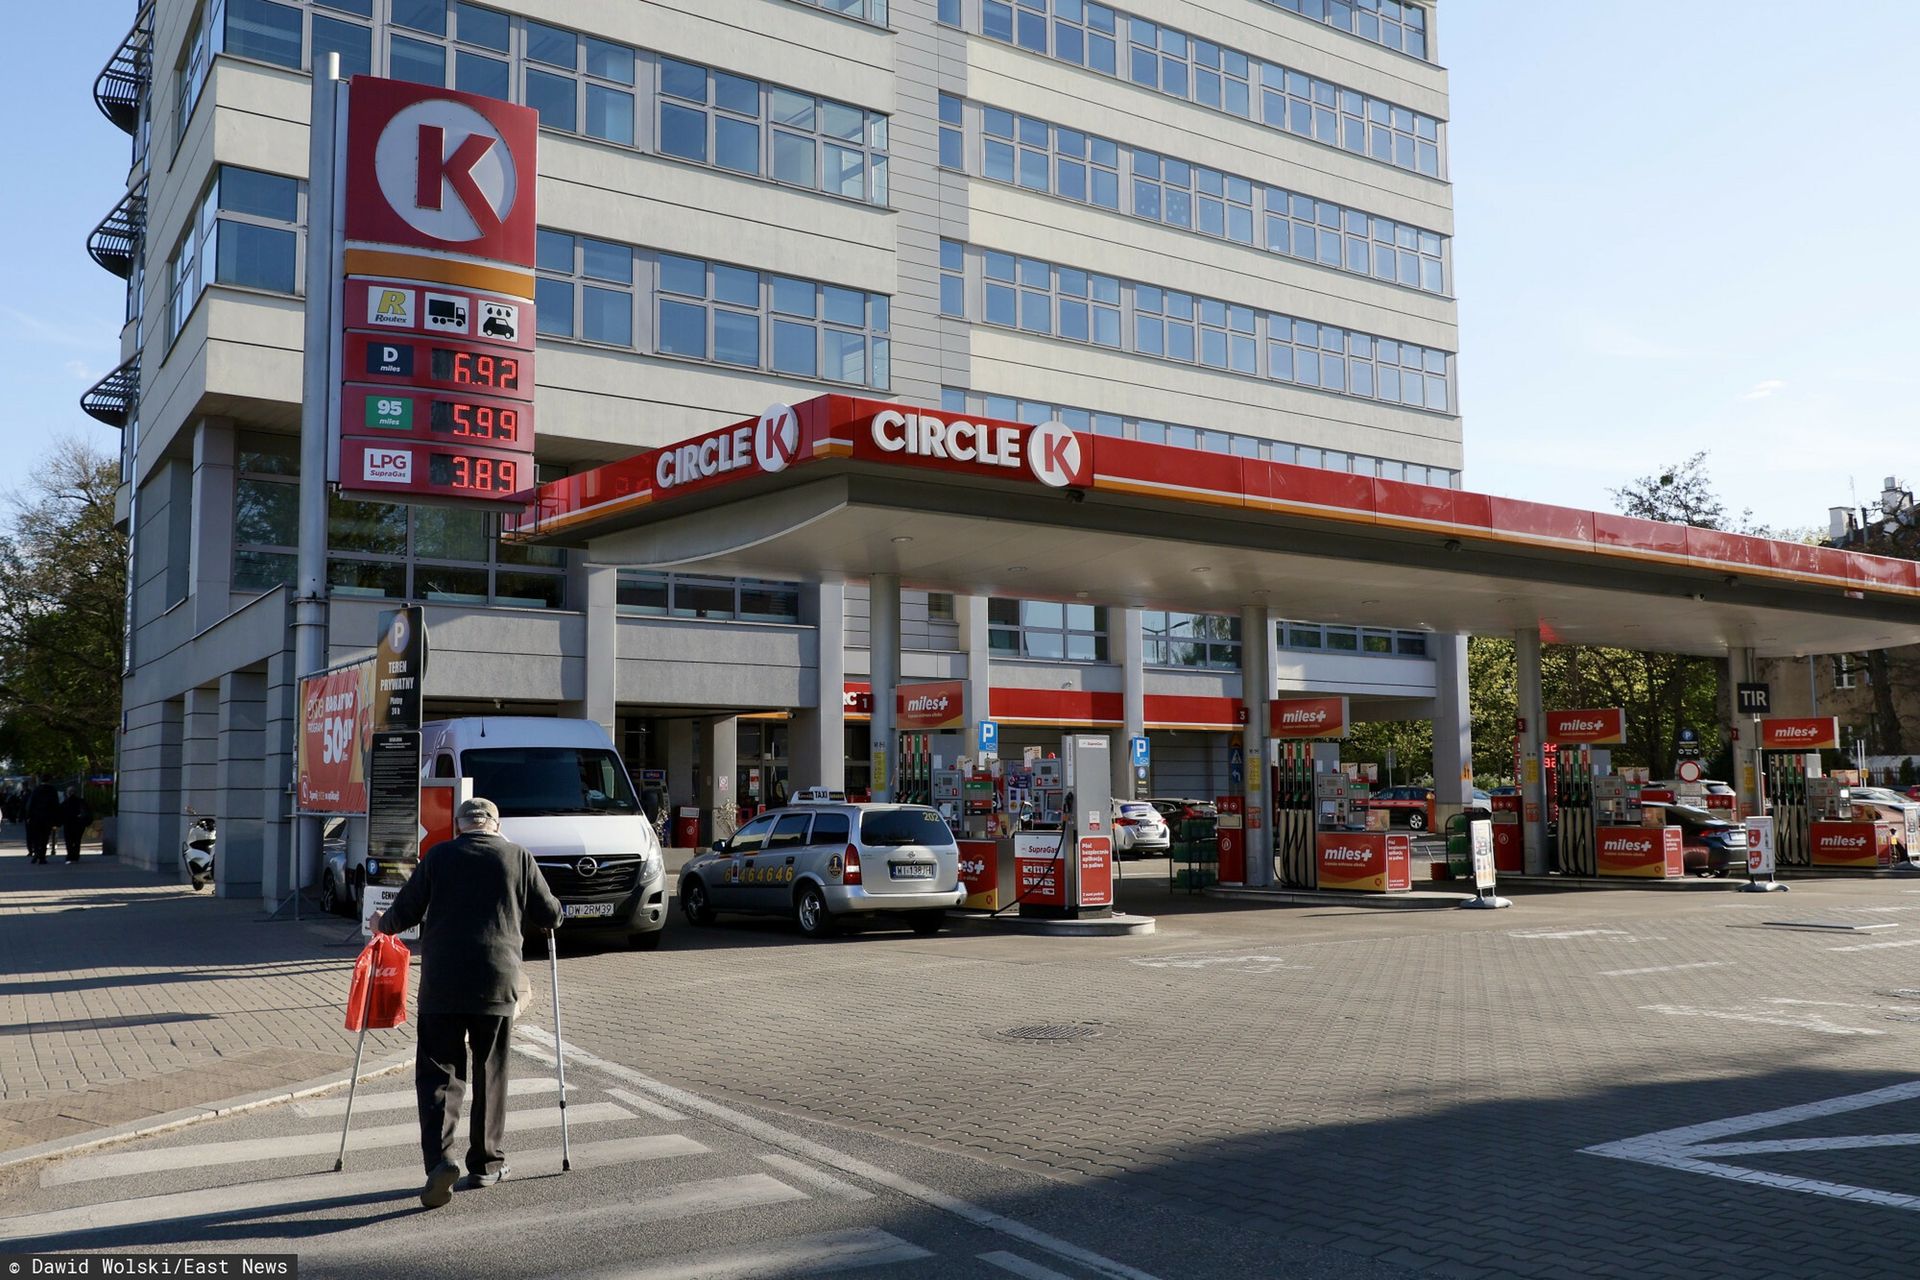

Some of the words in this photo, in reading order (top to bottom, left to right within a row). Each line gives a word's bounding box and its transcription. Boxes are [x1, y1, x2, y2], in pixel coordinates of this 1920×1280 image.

[375, 314, 407, 324] Routex
[383, 347, 398, 362] D
[380, 365, 400, 373] miles
[454, 353, 516, 389] 6.92
[377, 399, 402, 416] 95
[453, 404, 516, 441] 5.99
[871, 410, 1021, 469] CIRCLE
[370, 454, 406, 470] LPG
[656, 427, 753, 488] CIRCLE
[370, 469, 406, 478] SupraGas
[452, 456, 516, 493] 3.89
[394, 622, 404, 647] P
[388, 660, 407, 674] TEREN
[380, 677, 415, 692] PRYWATNY
[908, 696, 948, 711] miles+
[1740, 690, 1767, 706] TIR
[1240, 711, 1246, 720] 3
[1283, 710, 1326, 723] miles+
[1560, 719, 1604, 731] miles+
[1774, 727, 1818, 737] miles+
[983, 724, 994, 743] P
[1137, 740, 1146, 757] P
[815, 791, 828, 799] TAXI
[922, 812, 940, 822] 202
[1604, 839, 1652, 852] miles+
[1820, 834, 1867, 846] miles+
[1324, 847, 1372, 861] miles+
[568, 905, 580, 916] DW
